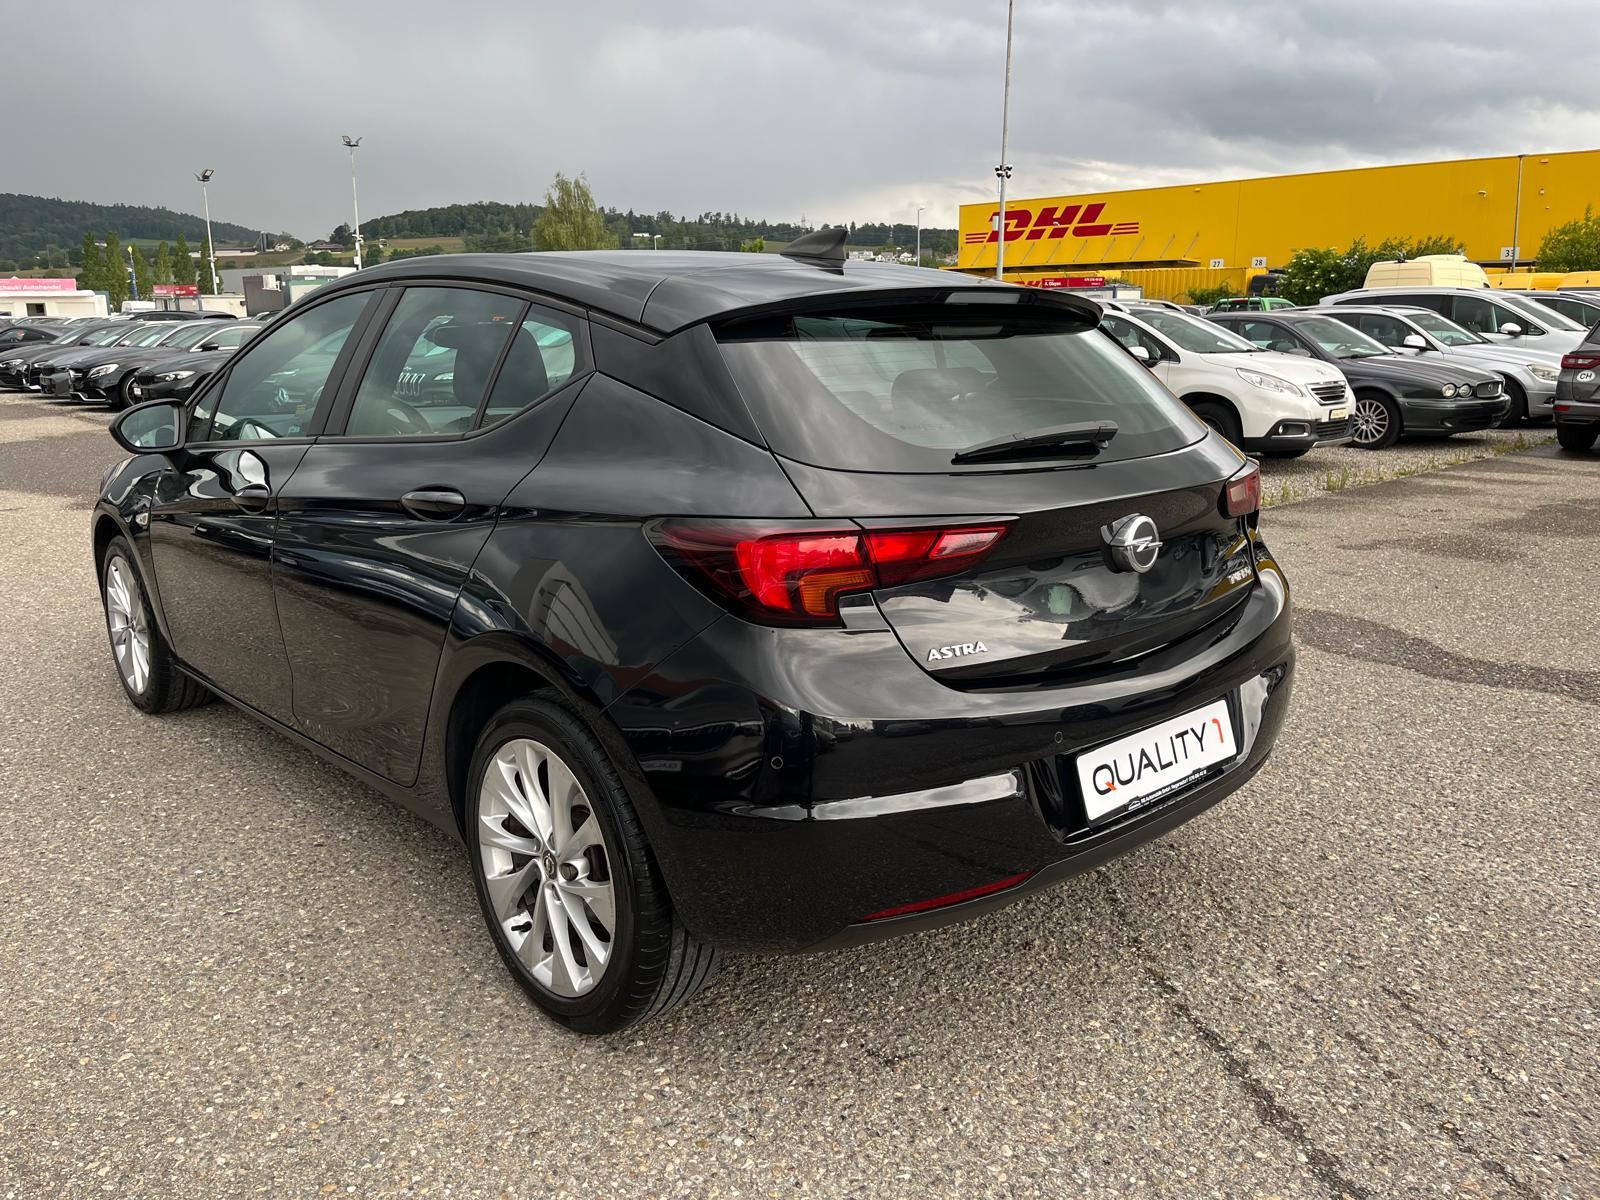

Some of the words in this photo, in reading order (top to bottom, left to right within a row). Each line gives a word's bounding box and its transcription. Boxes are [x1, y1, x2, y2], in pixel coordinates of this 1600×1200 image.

[986, 202, 1114, 243] DHL
[1579, 372, 1593, 380] CH
[927, 641, 988, 662] ASTRA
[1092, 722, 1206, 796] QUALITY
